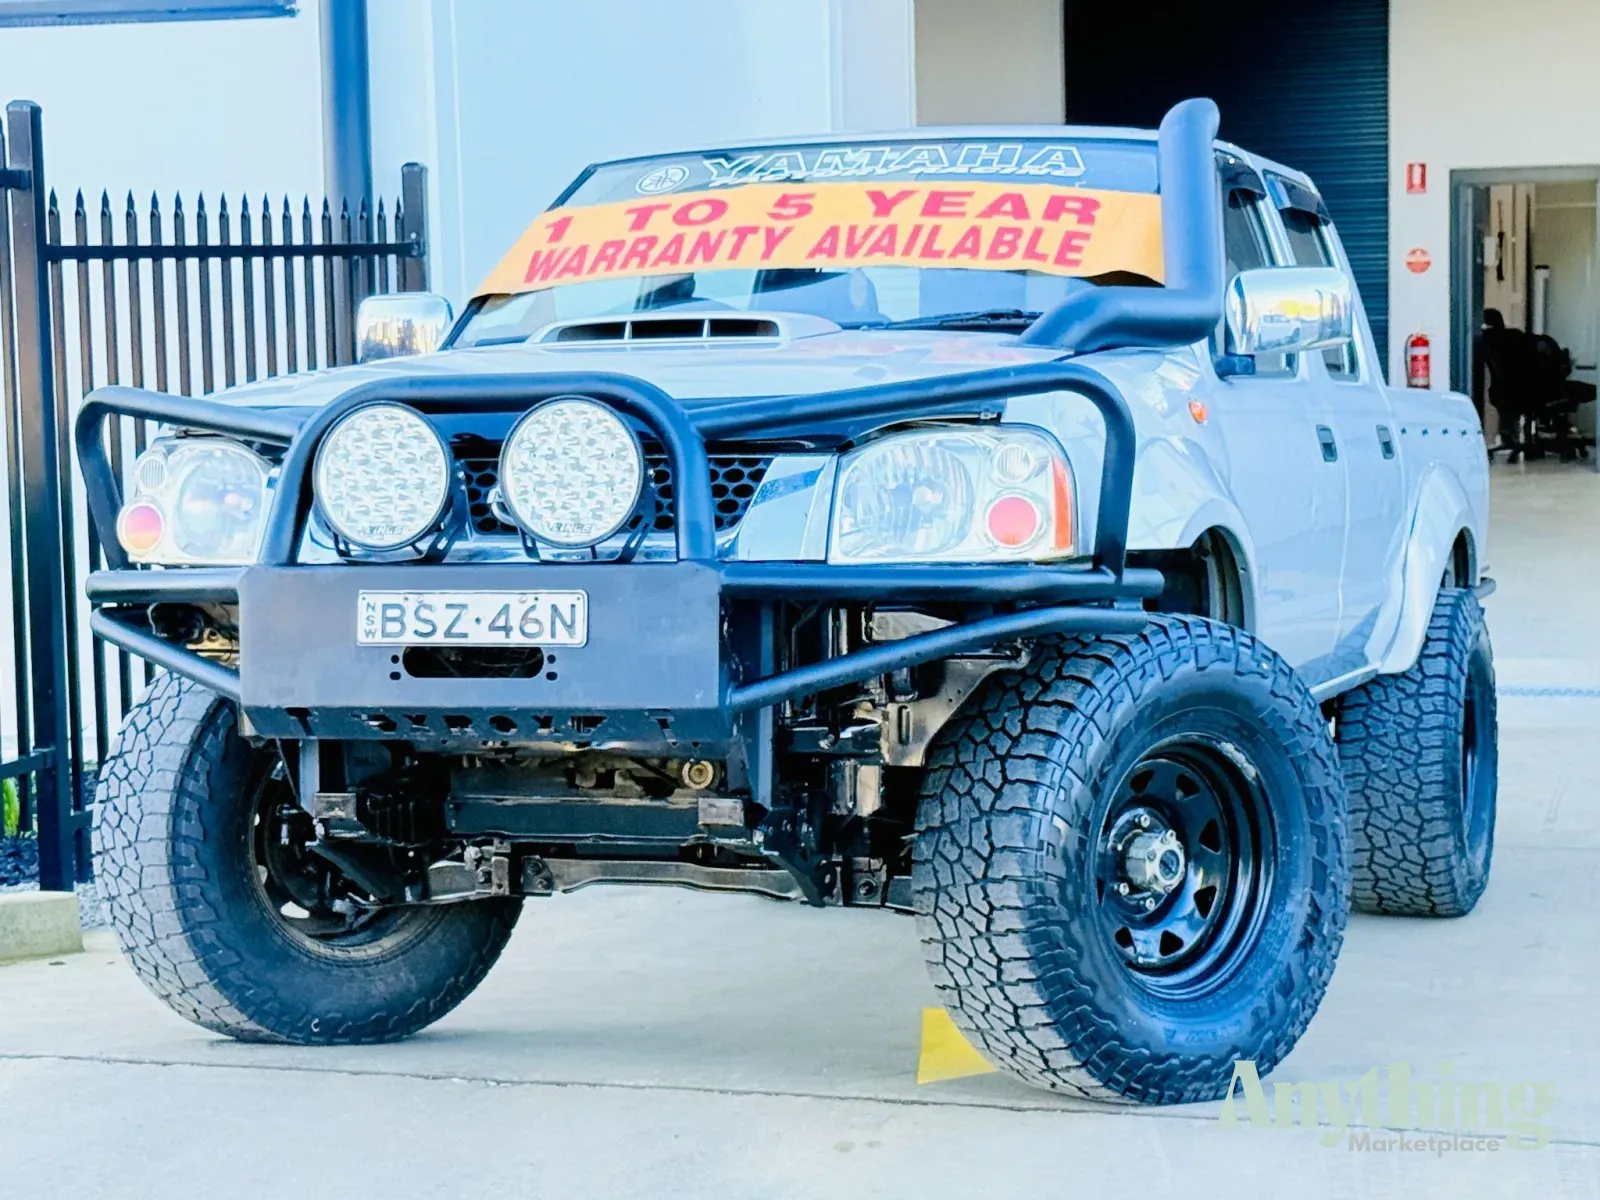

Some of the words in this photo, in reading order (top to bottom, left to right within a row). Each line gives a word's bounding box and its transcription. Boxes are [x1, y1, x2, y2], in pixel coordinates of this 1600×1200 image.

[702, 144, 1086, 181] YAMAHA
[544, 215, 573, 244] 1
[624, 199, 728, 232] TO
[768, 192, 817, 220] 5
[865, 190, 1103, 226] YEAR
[523, 227, 794, 284] WARRANTY
[805, 223, 1091, 267] AVAILABLE
